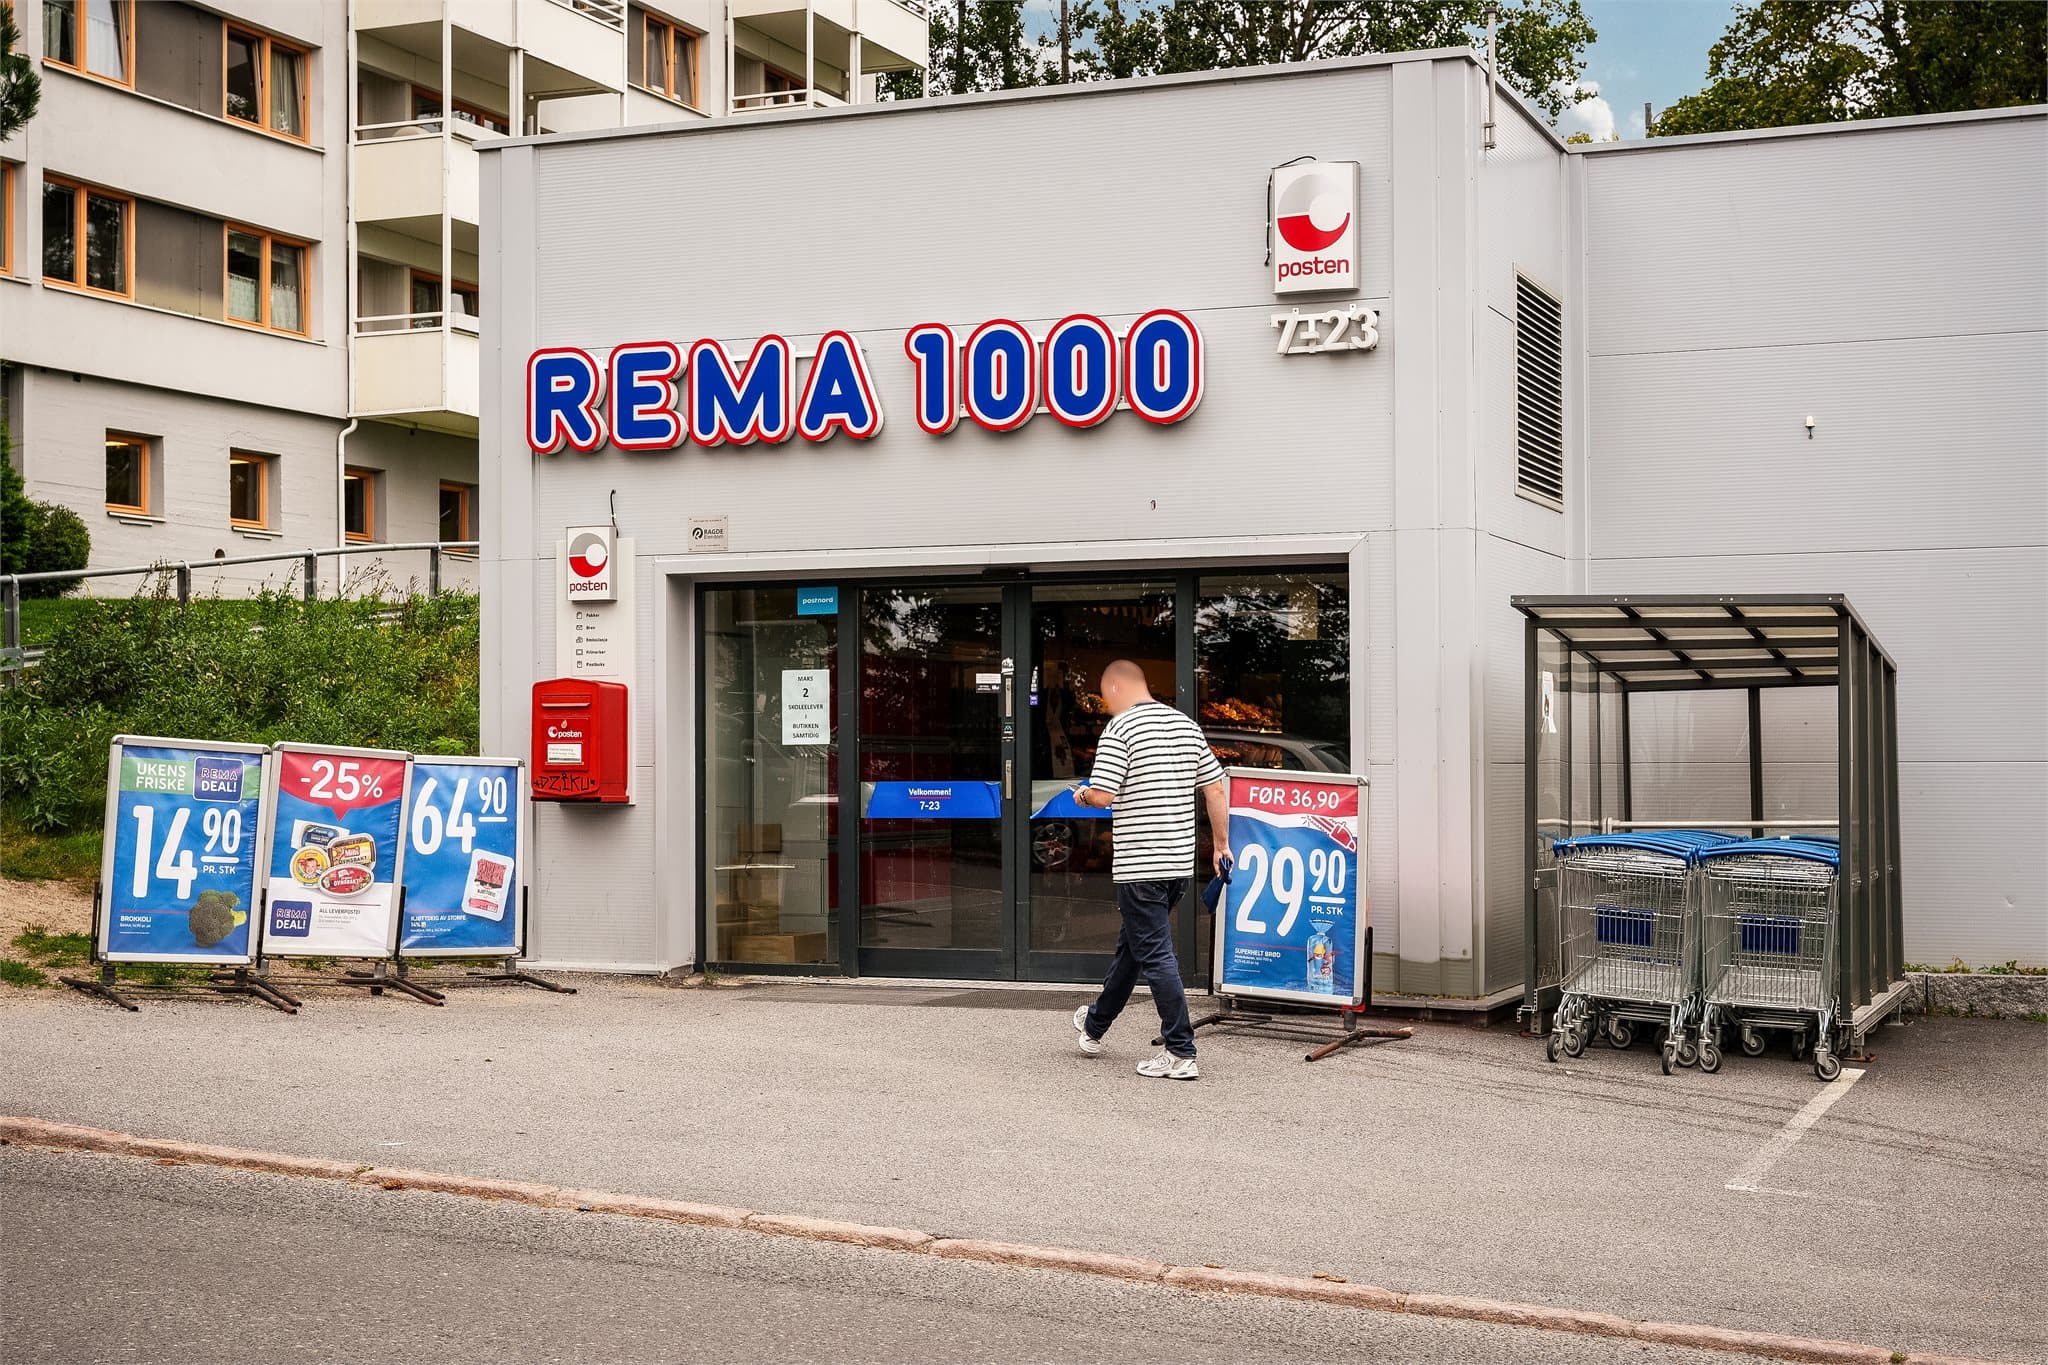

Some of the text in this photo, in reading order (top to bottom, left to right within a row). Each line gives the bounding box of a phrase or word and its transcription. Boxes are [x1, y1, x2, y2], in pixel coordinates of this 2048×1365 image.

[1278, 257, 1350, 282] posten
[1271, 308, 1379, 355] 7-23
[527, 309, 1204, 455] REMA 1000
[569, 580, 608, 594] posten
[802, 596, 834, 605] postnord
[802, 687, 809, 698] 2
[557, 729, 583, 739] posten
[137, 763, 186, 778] UKENS
[201, 768, 239, 781] REMA
[136, 777, 185, 791] FRISKE
[301, 759, 383, 801] -25%
[201, 781, 237, 793] DEAL!
[908, 787, 952, 797] Velkommen!
[1249, 786, 1340, 810] FØR 36,90
[919, 801, 940, 811] 7-23
[411, 776, 508, 855] 64 90
[132, 805, 242, 900] 14 90
[202, 865, 236, 874] PR. STK
[1235, 843, 1347, 938] 29 90
[276, 908, 308, 919] REMA
[1311, 905, 1344, 916] PR. STK
[276, 919, 306, 930] DEAL!
